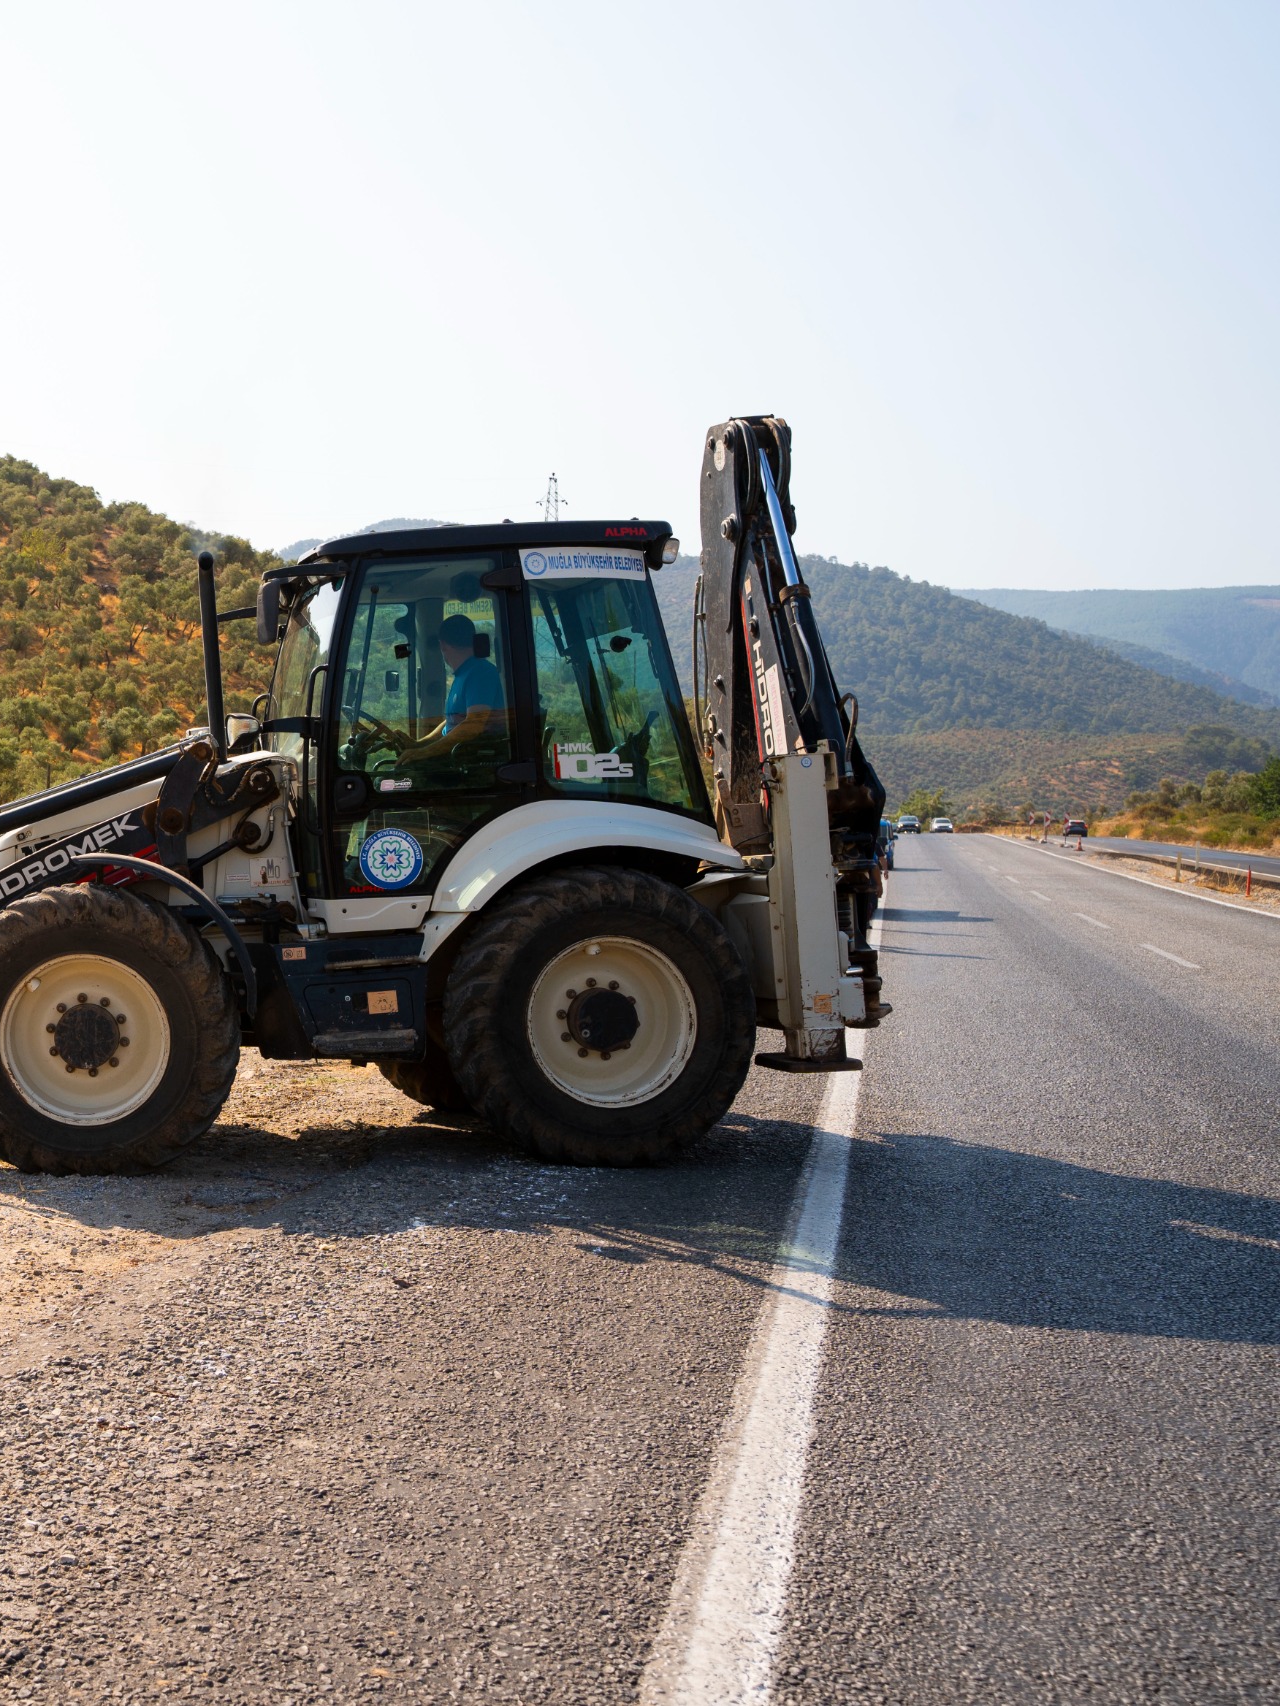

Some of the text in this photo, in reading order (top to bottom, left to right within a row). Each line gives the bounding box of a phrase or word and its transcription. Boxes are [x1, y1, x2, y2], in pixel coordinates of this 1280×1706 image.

[604, 527, 648, 537] ALPHA
[548, 553, 573, 569] MUĞLA
[573, 552, 614, 573] BÜYÜKŞEHİR
[557, 742, 593, 753] HMK
